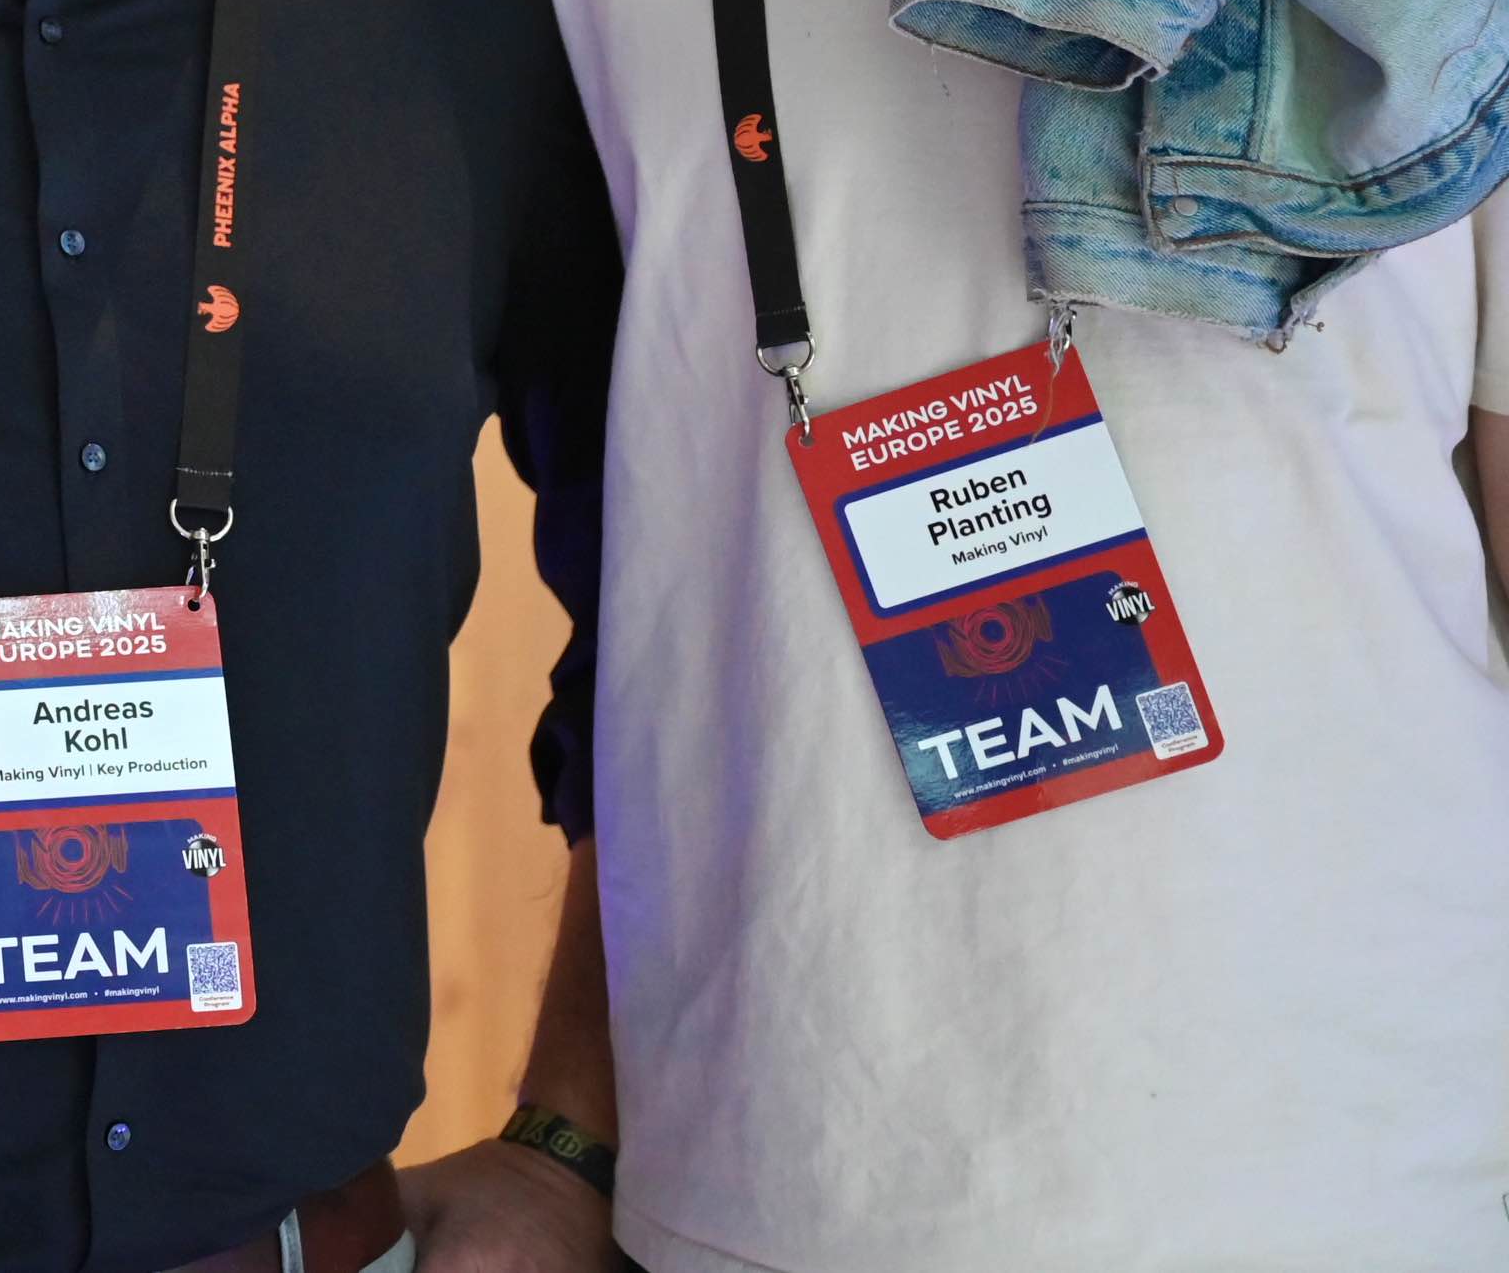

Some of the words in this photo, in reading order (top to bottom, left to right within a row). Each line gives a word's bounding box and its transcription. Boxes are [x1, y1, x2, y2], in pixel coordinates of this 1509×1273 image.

[219, 82, 241, 154] ALPHA
[213, 156, 237, 248] PHEENIX
[842, 400, 948, 449] MAKING
[949, 374, 1031, 412] VINYL
[850, 420, 964, 471] EUROPE
[968, 395, 1038, 433] 2025
[929, 469, 1027, 513] Ruben
[927, 493, 1052, 546] Planting
[951, 538, 1007, 565] Making
[1009, 525, 1048, 547] Vinyl
[88, 612, 165, 634] VINYL
[1105, 592, 1156, 622] VINYL
[99, 635, 167, 657] 2025
[33, 699, 154, 726] Andreas
[917, 684, 1122, 780] TEAM
[64, 727, 128, 753] Kohl
[48, 764, 85, 780] Vinyl
[97, 762, 124, 777] Key
[128, 758, 208, 773] Production
[954, 765, 1047, 799] www.makingvinyl.com
[1062, 743, 1119, 767] #makingvinyl
[182, 848, 227, 870] VINYL
[104, 986, 160, 998] #makingvinyl
